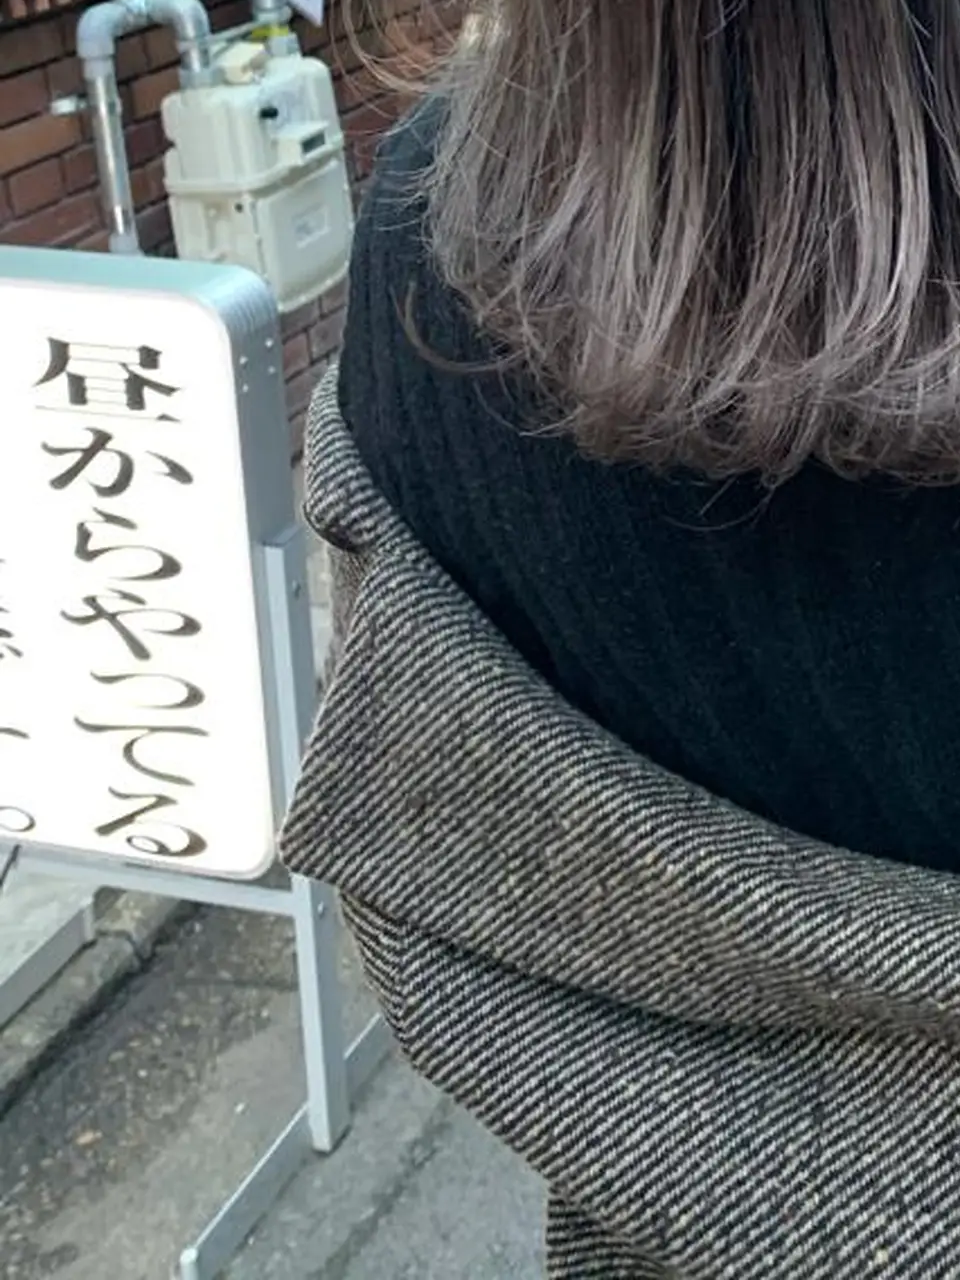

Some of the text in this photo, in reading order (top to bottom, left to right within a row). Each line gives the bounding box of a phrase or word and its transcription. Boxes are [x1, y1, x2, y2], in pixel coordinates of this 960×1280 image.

[34, 336, 209, 858] 昼からやってる
